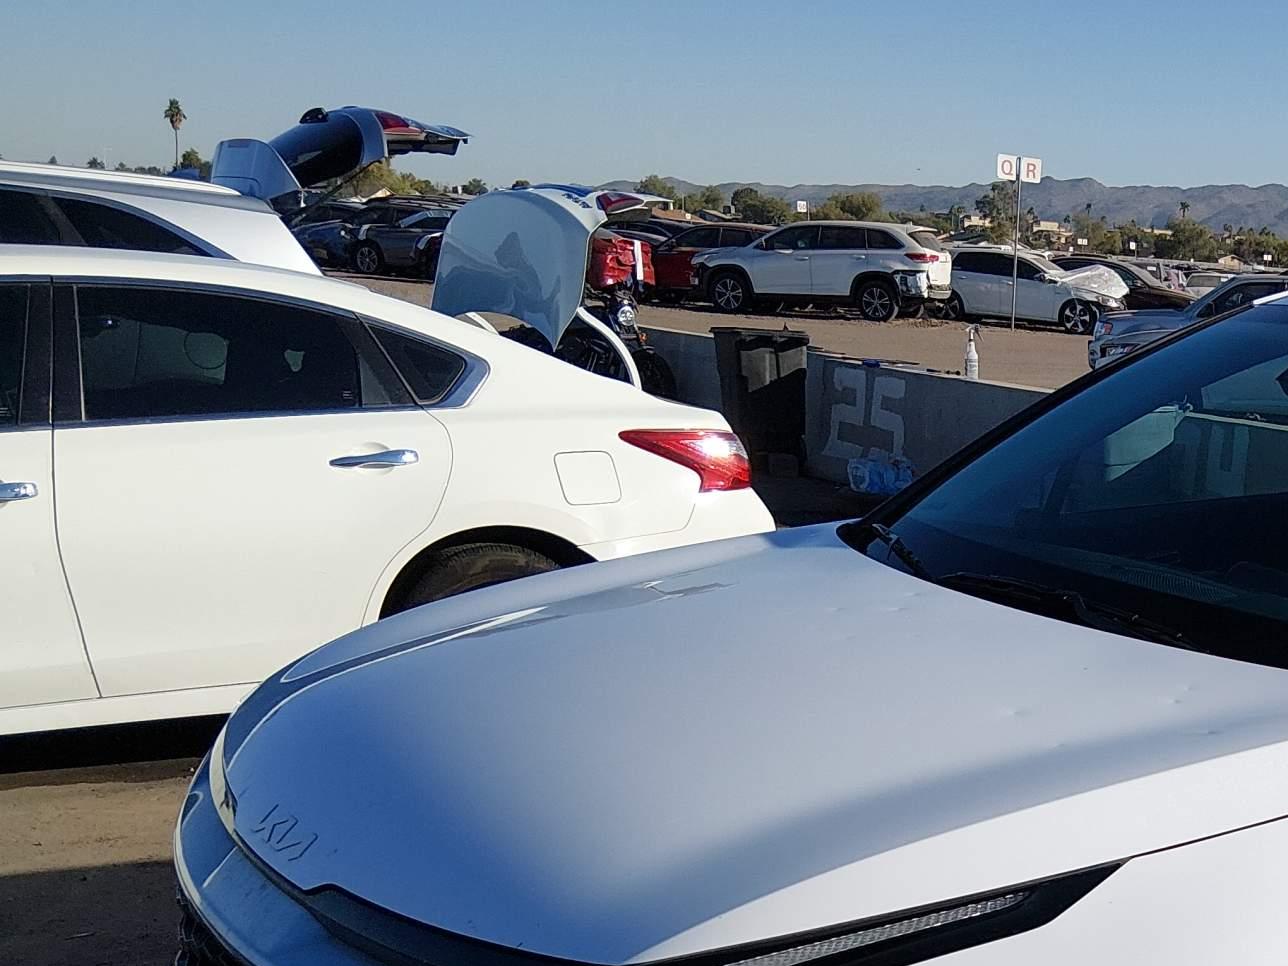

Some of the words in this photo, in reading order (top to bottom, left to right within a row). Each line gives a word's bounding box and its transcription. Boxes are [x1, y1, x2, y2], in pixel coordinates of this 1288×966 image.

[1001, 159, 1014, 176] Q
[1026, 162, 1037, 179] R
[822, 367, 906, 460] 25
